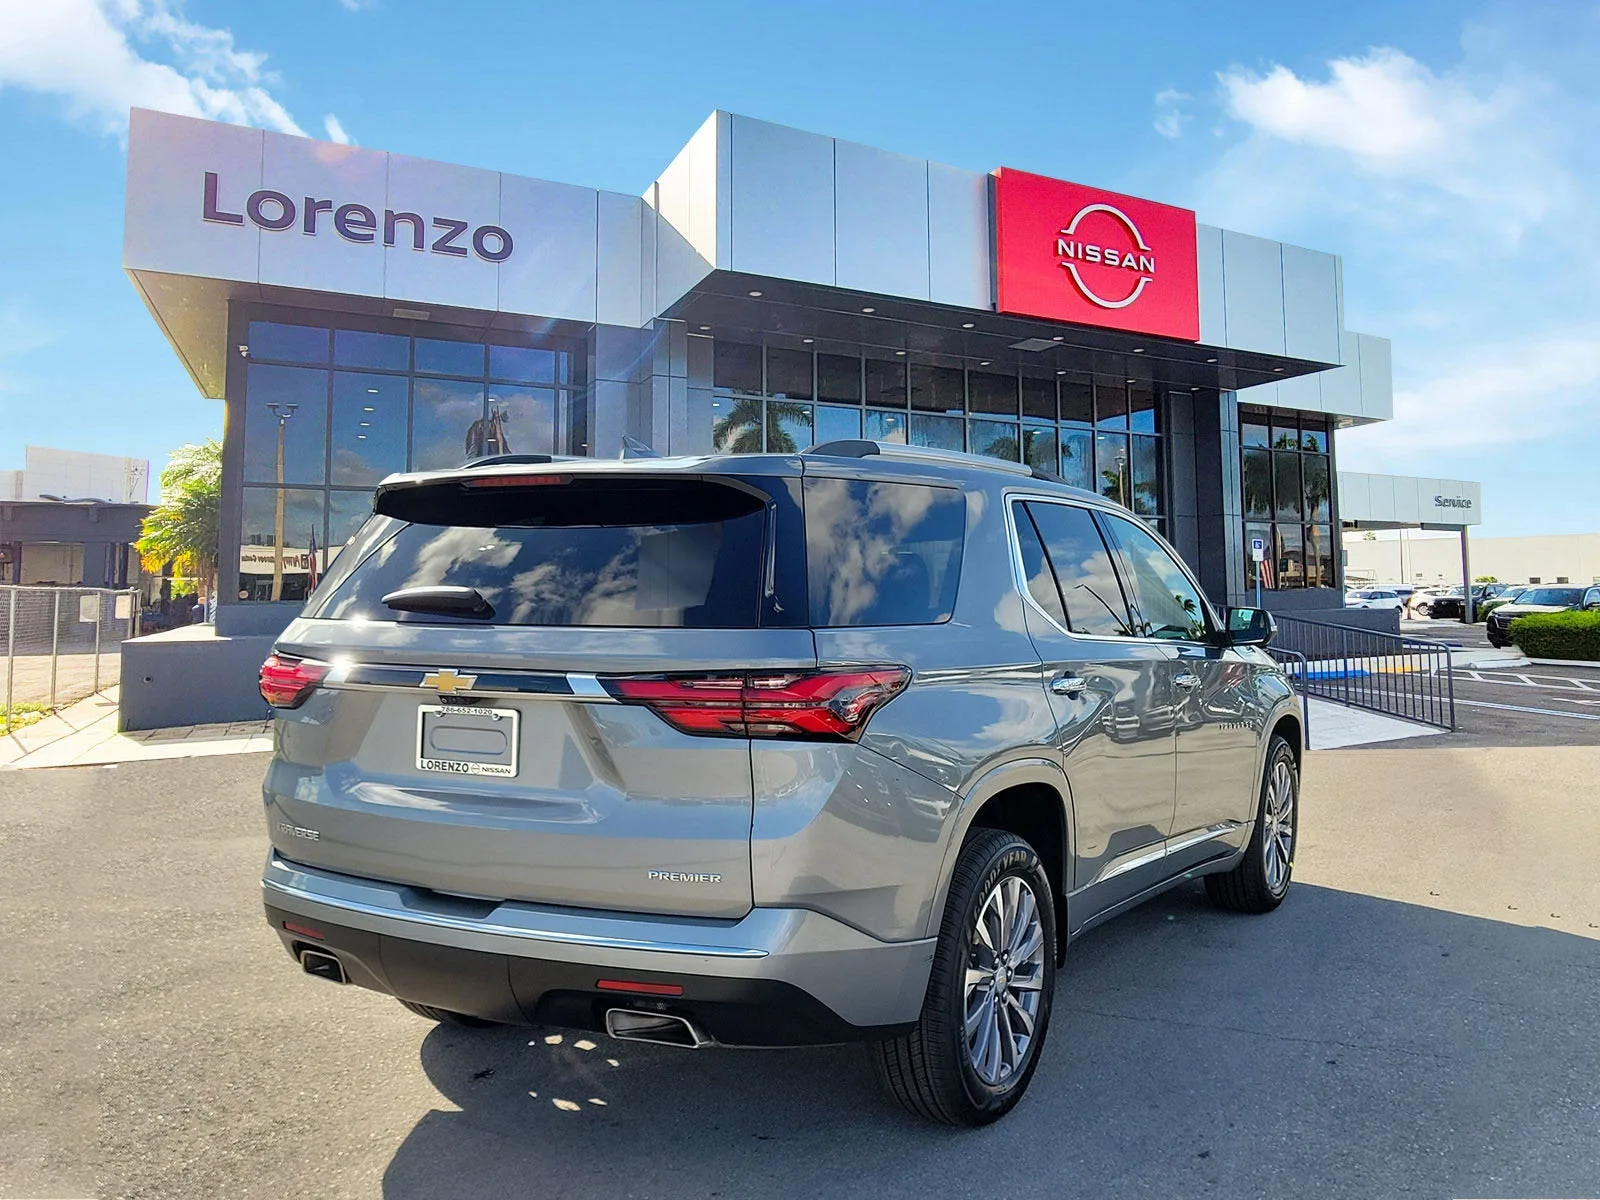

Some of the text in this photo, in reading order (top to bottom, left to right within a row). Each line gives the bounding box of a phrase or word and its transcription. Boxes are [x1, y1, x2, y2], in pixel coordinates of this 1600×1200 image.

[202, 171, 514, 262] Lorenzo
[1056, 238, 1155, 273] NISSAN
[1434, 495, 1472, 509] Service
[420, 759, 511, 774] LORENZO NISSAN
[647, 869, 722, 883] PREMIER
